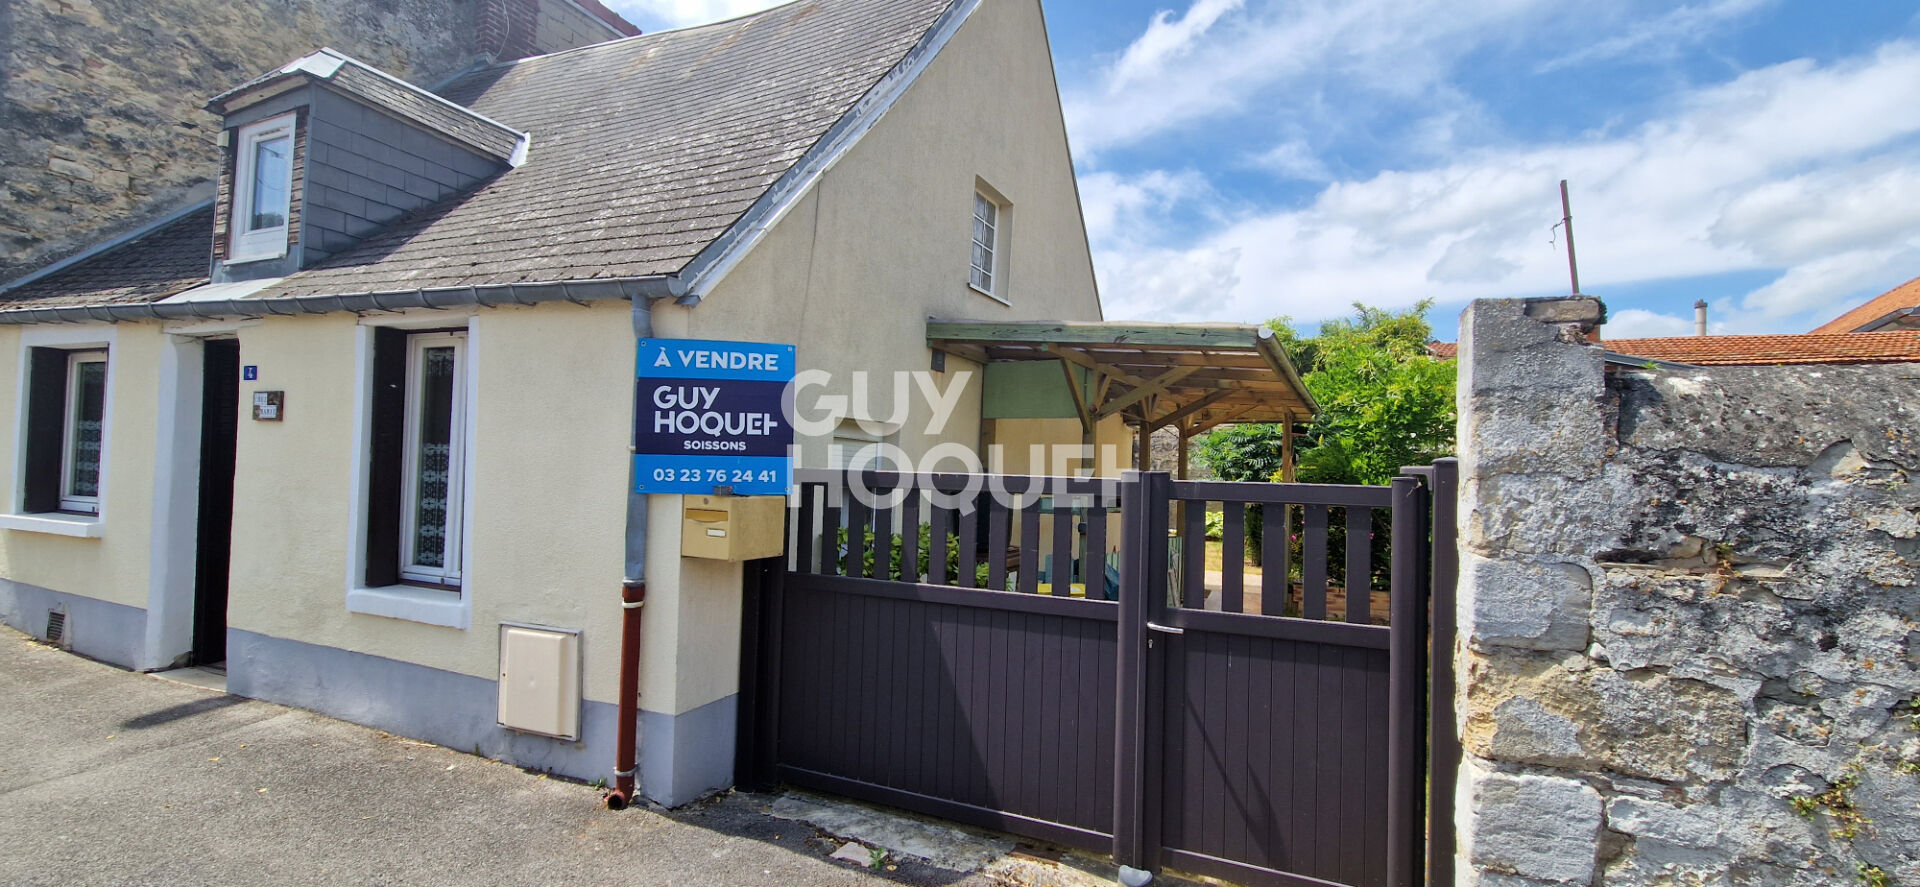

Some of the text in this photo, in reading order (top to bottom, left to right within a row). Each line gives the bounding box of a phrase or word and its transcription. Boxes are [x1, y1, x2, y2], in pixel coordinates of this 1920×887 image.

[654, 347, 779, 371] À VENDRE
[653, 385, 720, 410] GUY
[654, 410, 778, 438] HOQUET
[683, 440, 747, 451] SOISSONS
[653, 468, 777, 483] 03 23 76 24 41
